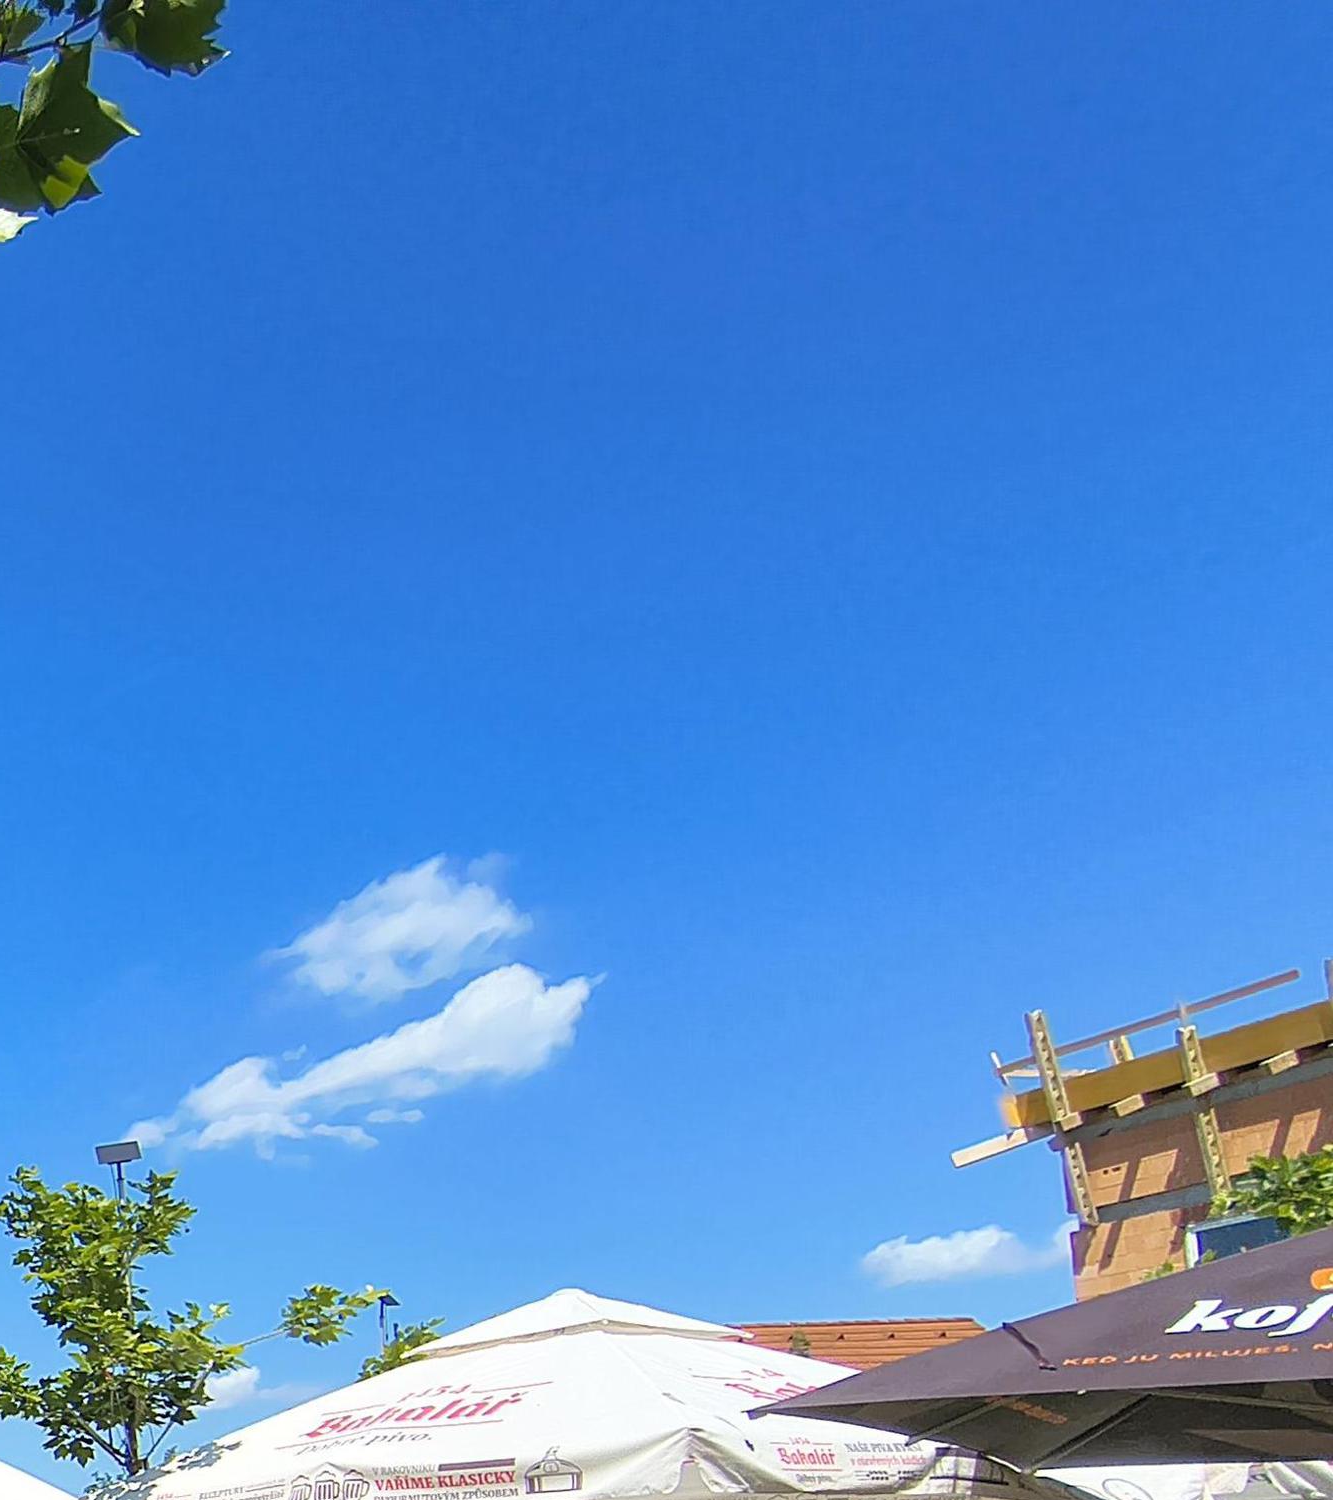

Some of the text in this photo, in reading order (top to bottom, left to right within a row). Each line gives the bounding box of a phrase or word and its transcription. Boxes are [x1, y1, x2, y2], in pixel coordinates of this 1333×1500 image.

[305, 1391, 525, 1438] Bakalář
[364, 1431, 433, 1446] pivo.
[777, 1448, 836, 1465] Bakalář
[374, 1471, 517, 1491] VAŘÍME KLASICKY
[462, 1487, 519, 1499] ZPŮSOBEM
